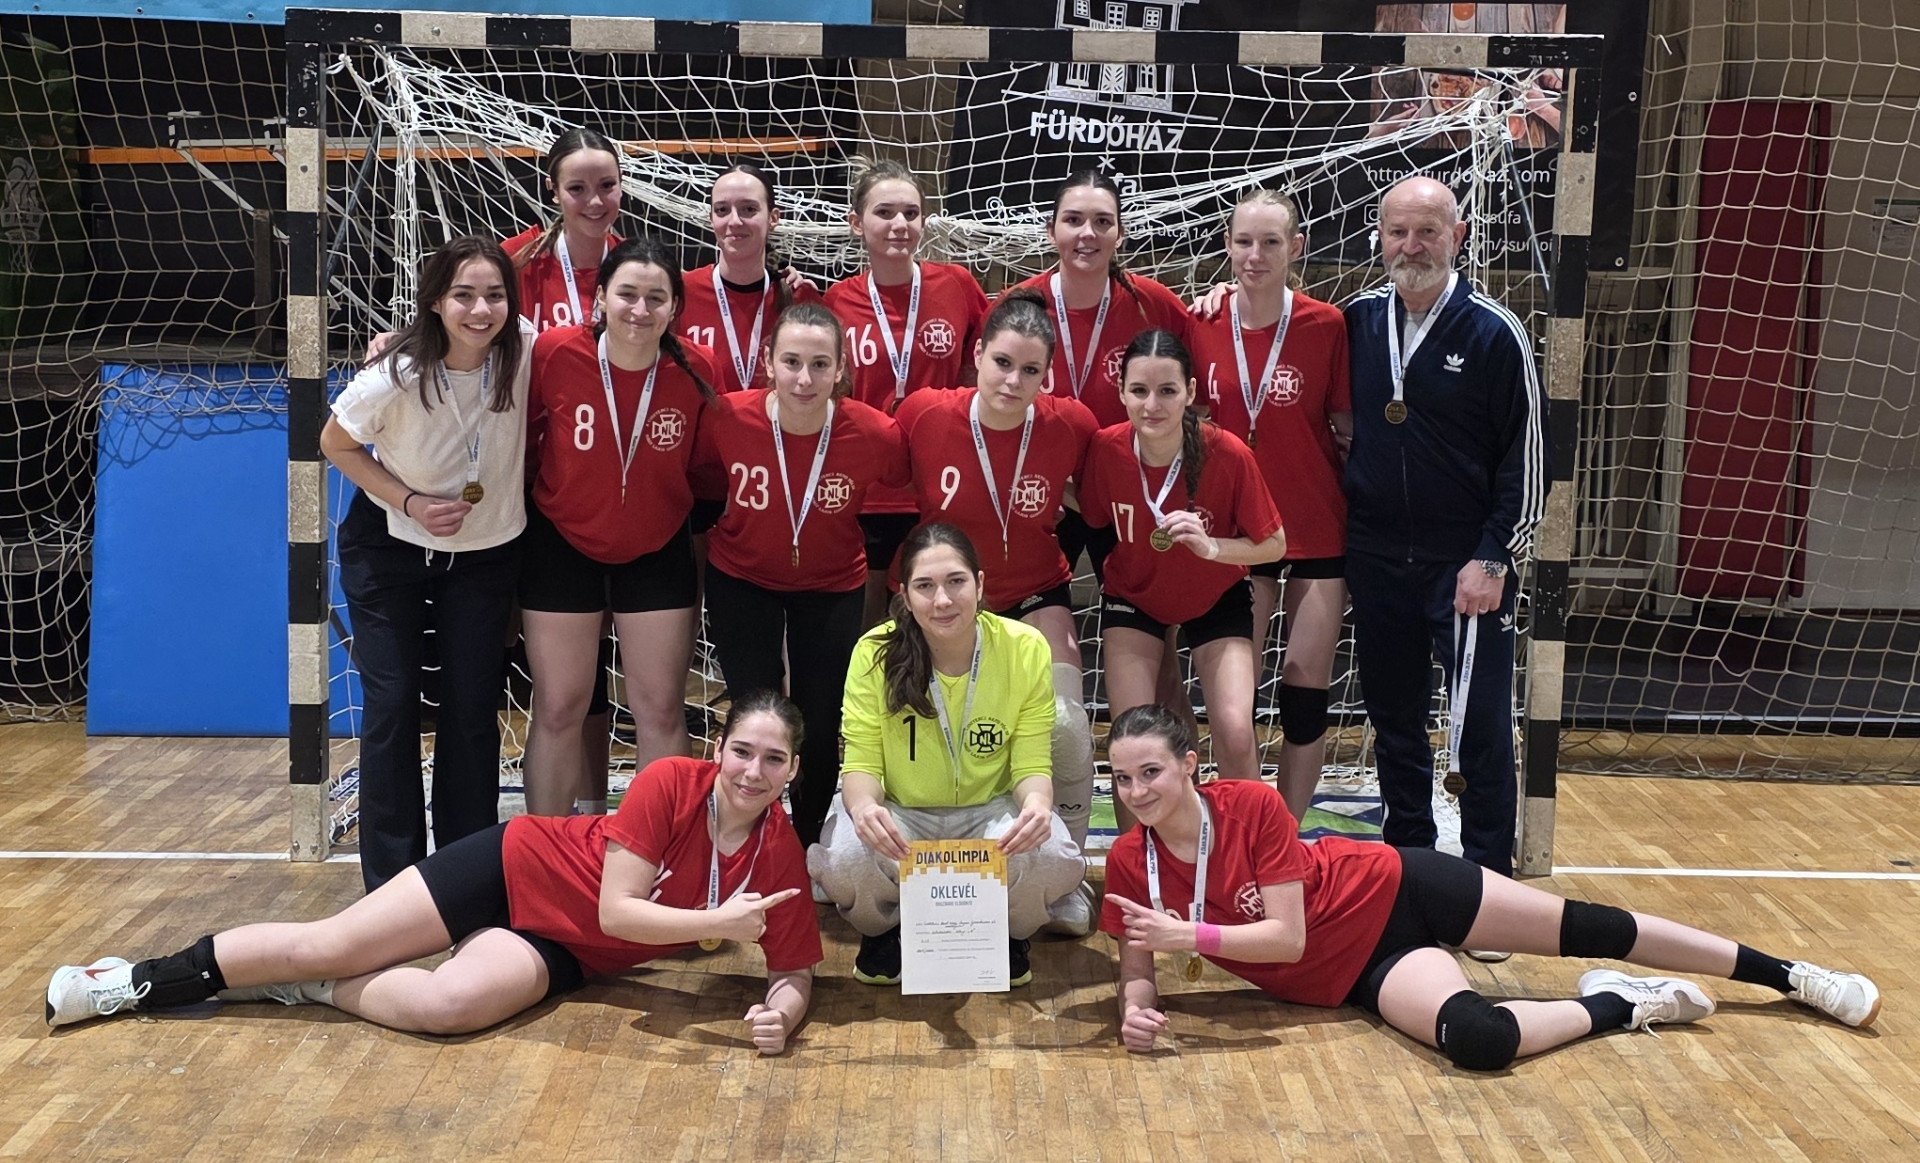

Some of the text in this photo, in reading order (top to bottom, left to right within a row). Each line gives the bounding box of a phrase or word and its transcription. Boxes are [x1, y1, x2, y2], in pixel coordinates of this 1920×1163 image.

[1030, 109, 1183, 151] FÜRDŐHÁZ
[845, 323, 878, 368] 16
[574, 404, 595, 451] 8
[731, 462, 769, 510] 23
[940, 466, 961, 511] 9
[1111, 501, 1135, 543] 17
[902, 714, 917, 762] 1
[930, 882, 978, 899] OKLEVÉL
